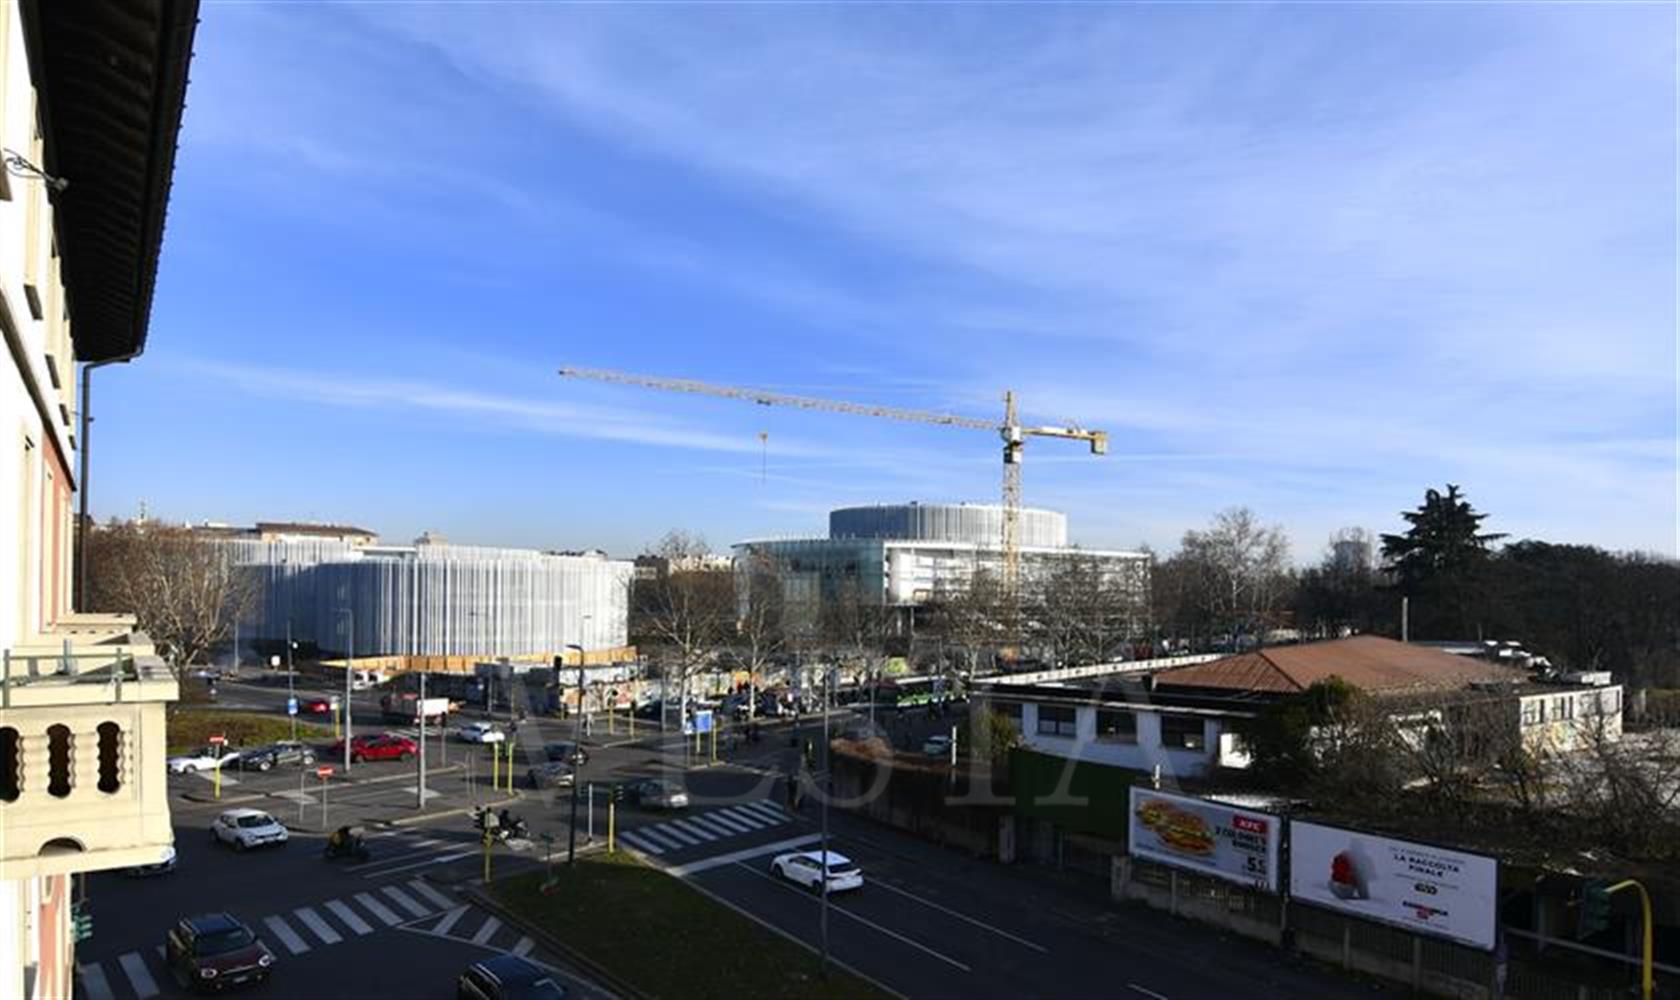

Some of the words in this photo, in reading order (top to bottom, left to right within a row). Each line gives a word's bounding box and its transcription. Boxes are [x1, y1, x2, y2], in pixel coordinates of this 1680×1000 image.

[1394, 853, 1406, 861] LA
[1408, 857, 1459, 873] RACCOLTA
[1408, 864, 1443, 878] FINALE
